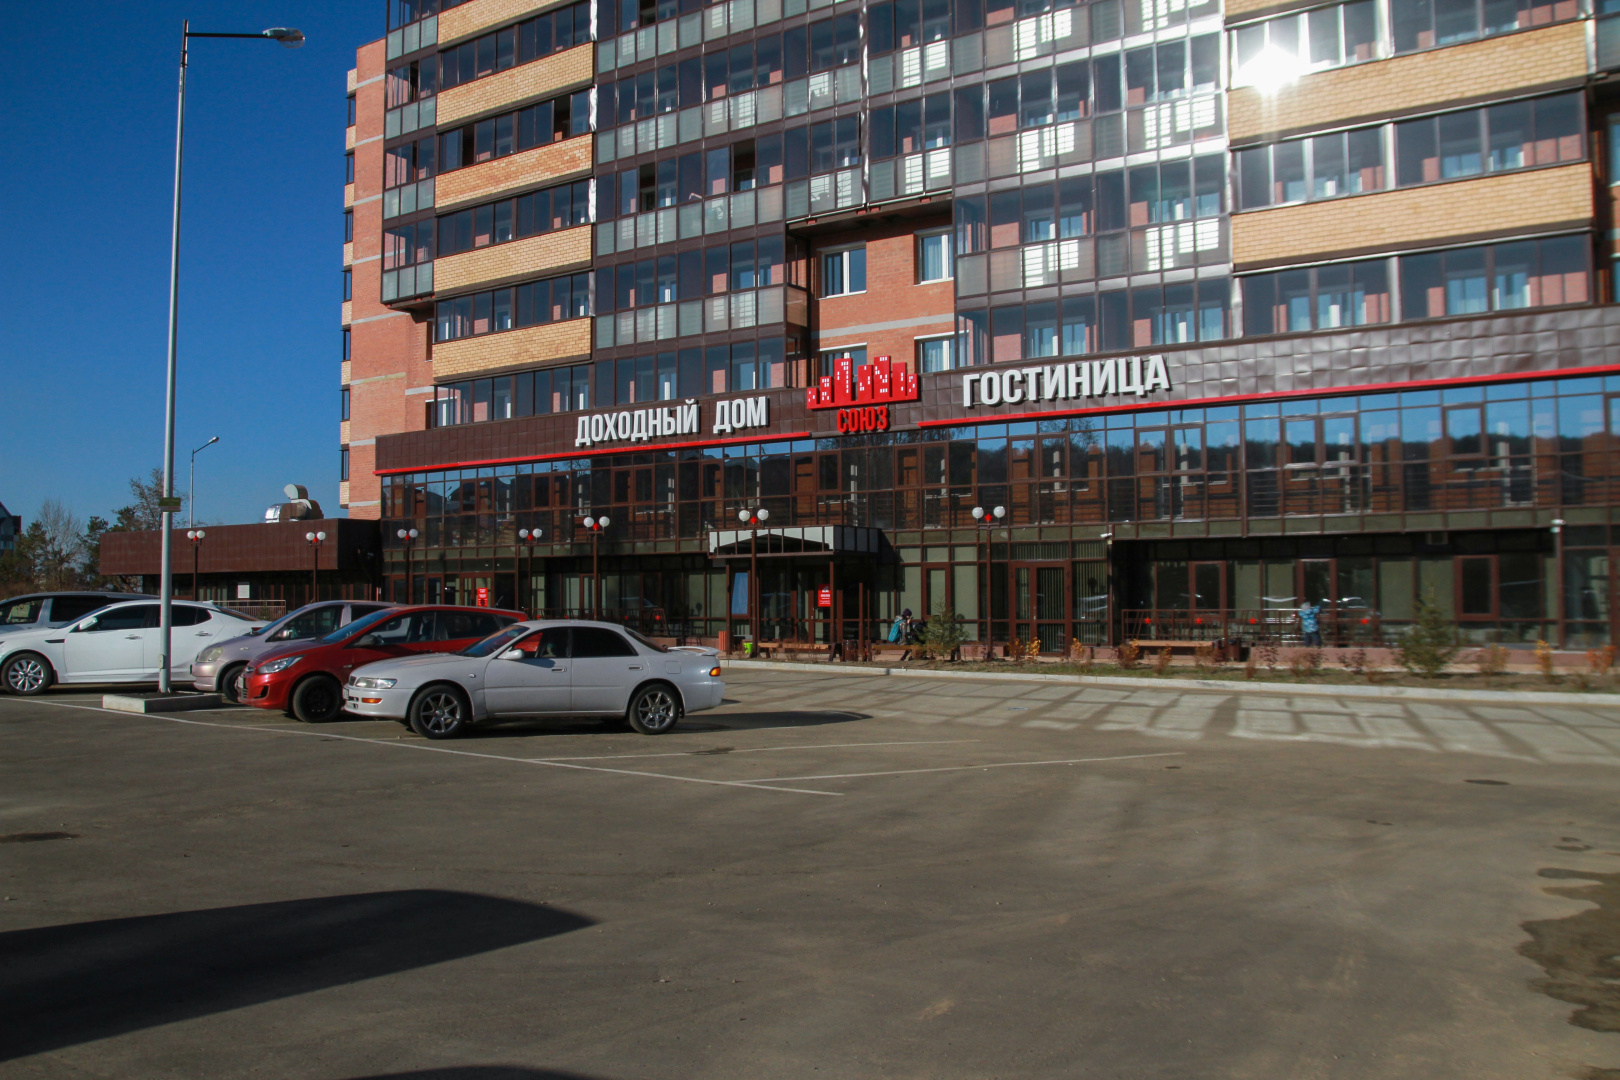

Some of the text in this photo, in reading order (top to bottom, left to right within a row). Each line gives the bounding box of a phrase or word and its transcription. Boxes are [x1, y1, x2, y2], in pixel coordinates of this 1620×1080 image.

[963, 355, 1170, 407] ГОСТИНИЦА
[575, 396, 768, 447] ДОХОДНЫЙ ДОМ
[837, 405, 888, 433] СОЮЗ
